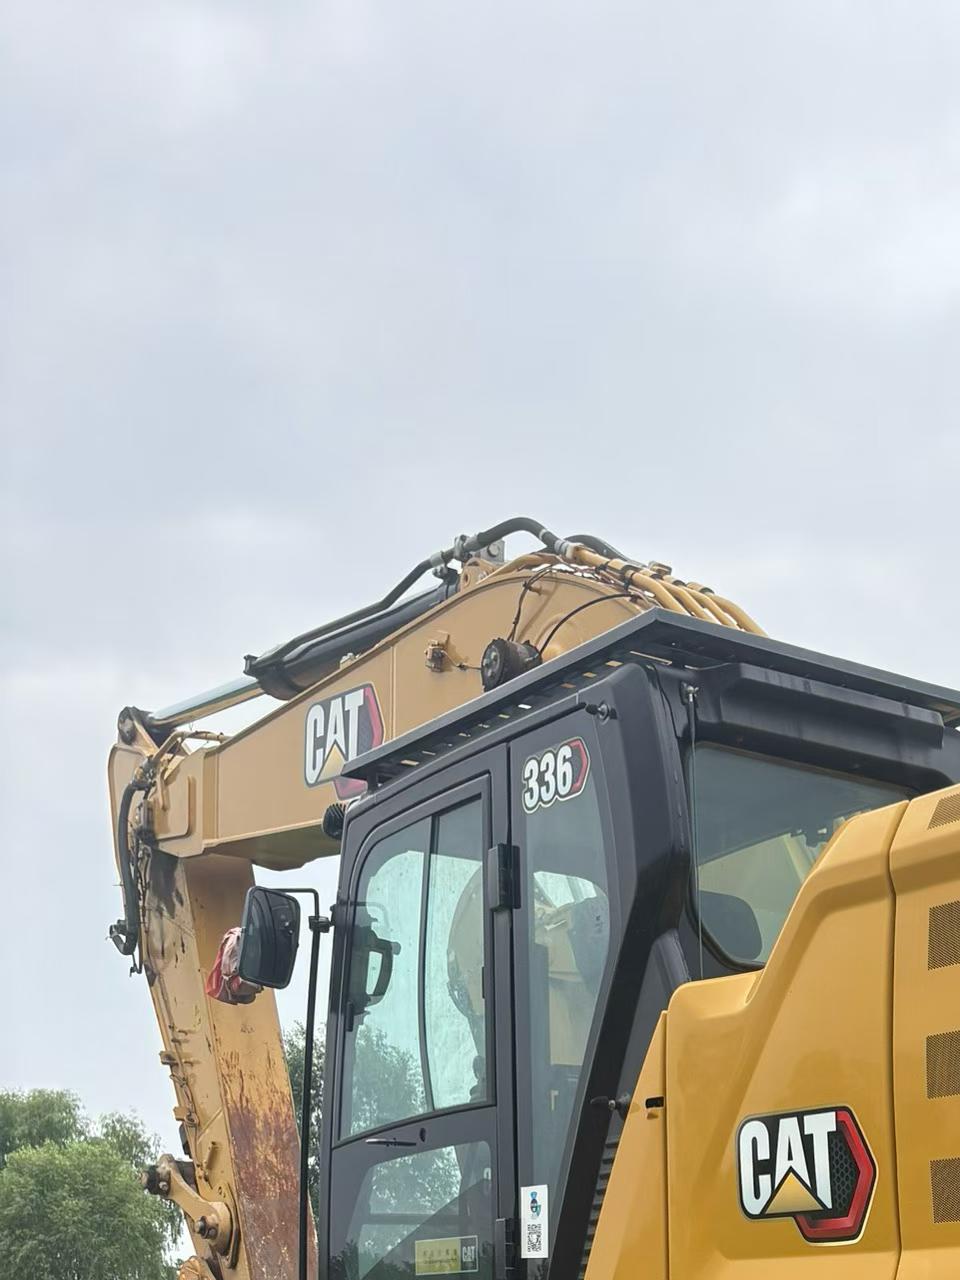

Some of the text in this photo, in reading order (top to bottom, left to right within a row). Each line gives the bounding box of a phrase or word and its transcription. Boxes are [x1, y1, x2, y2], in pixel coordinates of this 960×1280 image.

[306, 688, 365, 785] CAT
[524, 745, 574, 810] 336
[739, 1111, 837, 1216] CAT
[462, 1246, 476, 1262] CAT
